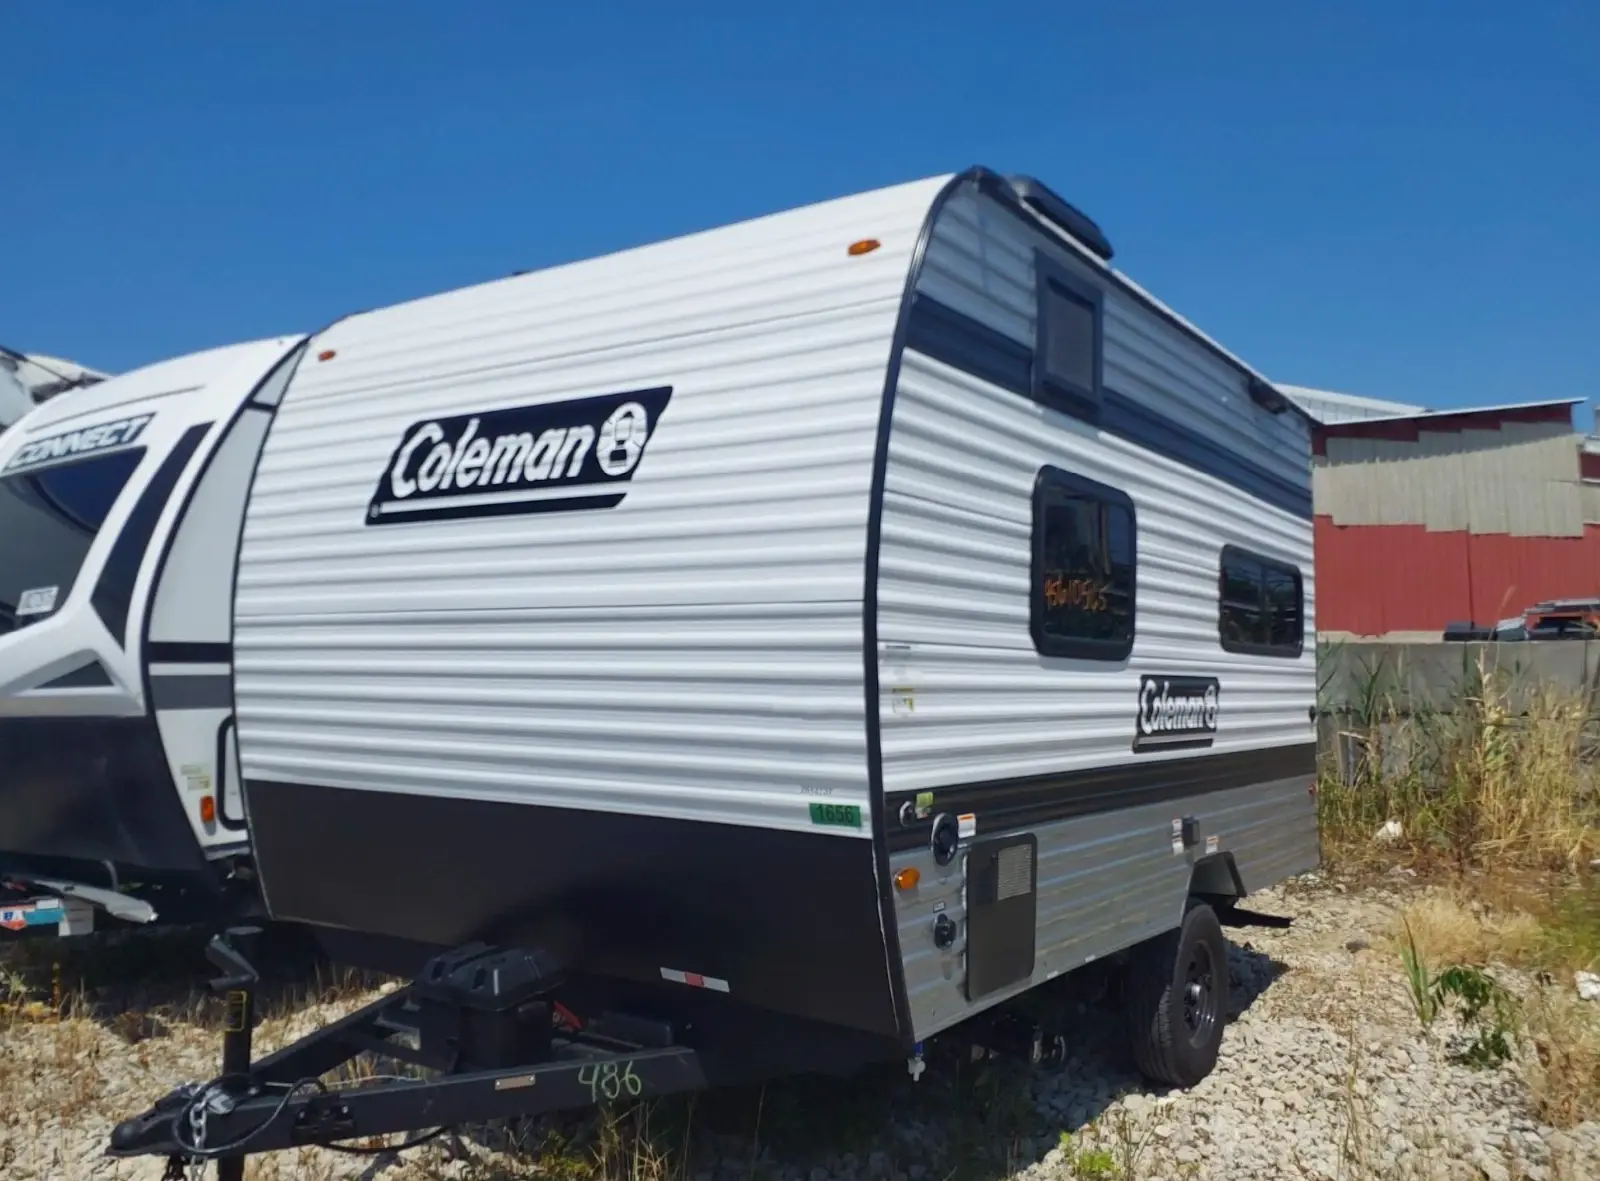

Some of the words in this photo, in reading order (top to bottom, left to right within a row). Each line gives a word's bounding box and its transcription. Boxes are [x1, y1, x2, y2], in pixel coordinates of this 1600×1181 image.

[13, 420, 141, 463] CONNECT
[391, 417, 596, 499] Coleman
[1141, 678, 1205, 735] Coleman
[814, 804, 856, 824] 1656
[577, 1060, 643, 1102] 486
